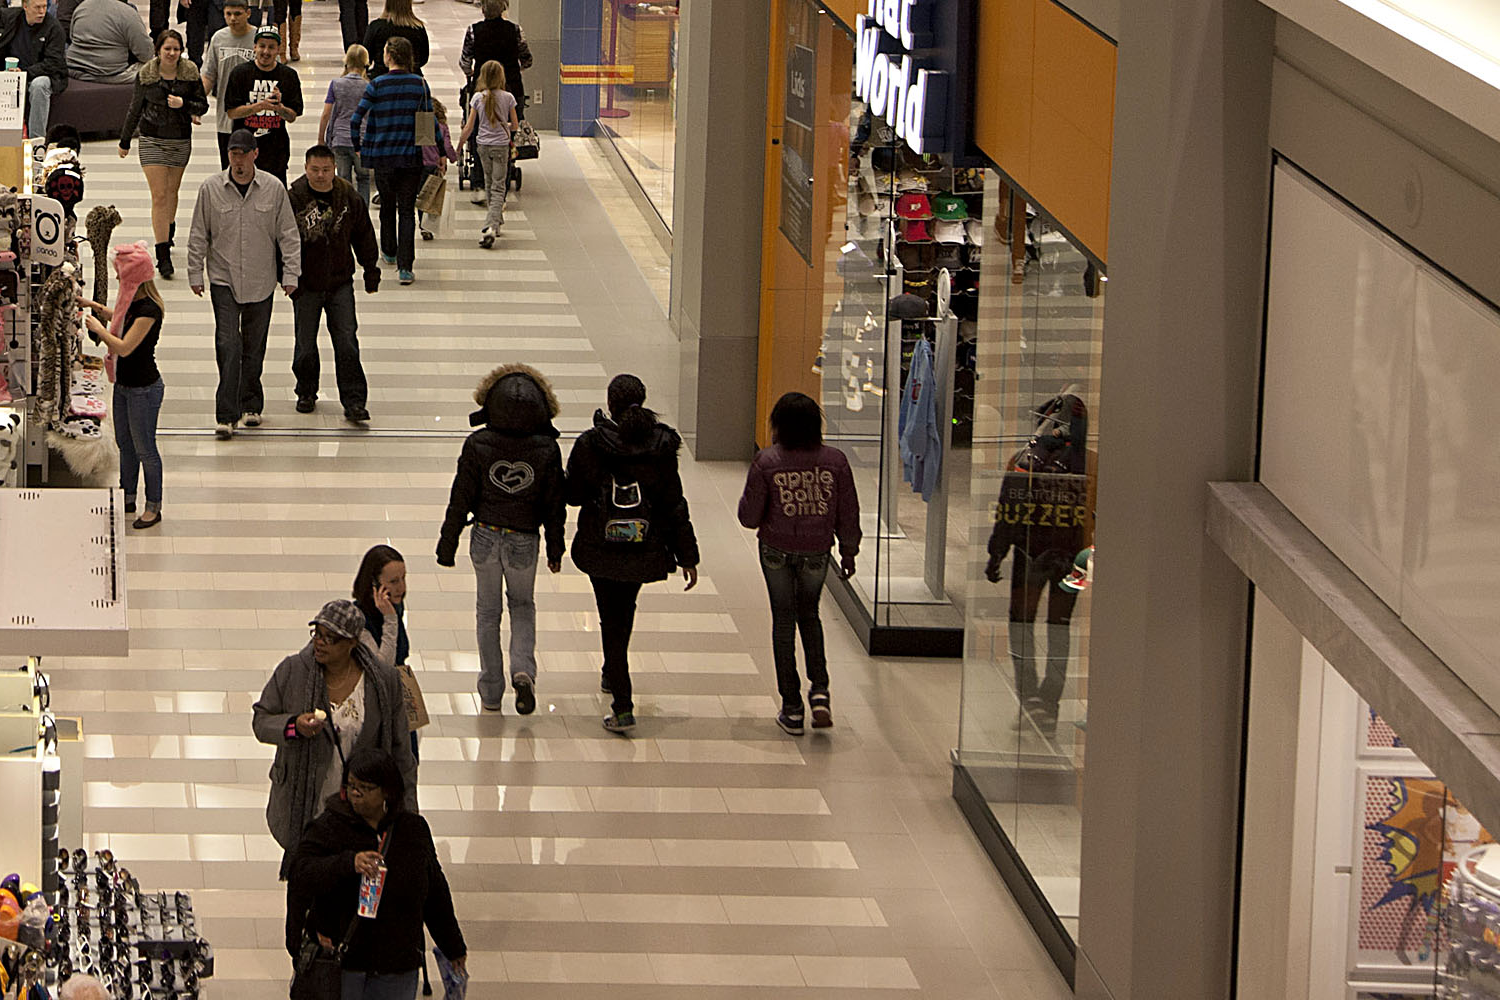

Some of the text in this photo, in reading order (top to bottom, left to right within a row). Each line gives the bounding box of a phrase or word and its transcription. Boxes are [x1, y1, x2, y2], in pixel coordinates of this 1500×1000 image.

[253, 79, 279, 92] MY
[856, 13, 928, 155] World
[773, 466, 834, 490] apple
[987, 502, 1087, 528] BUZZER
